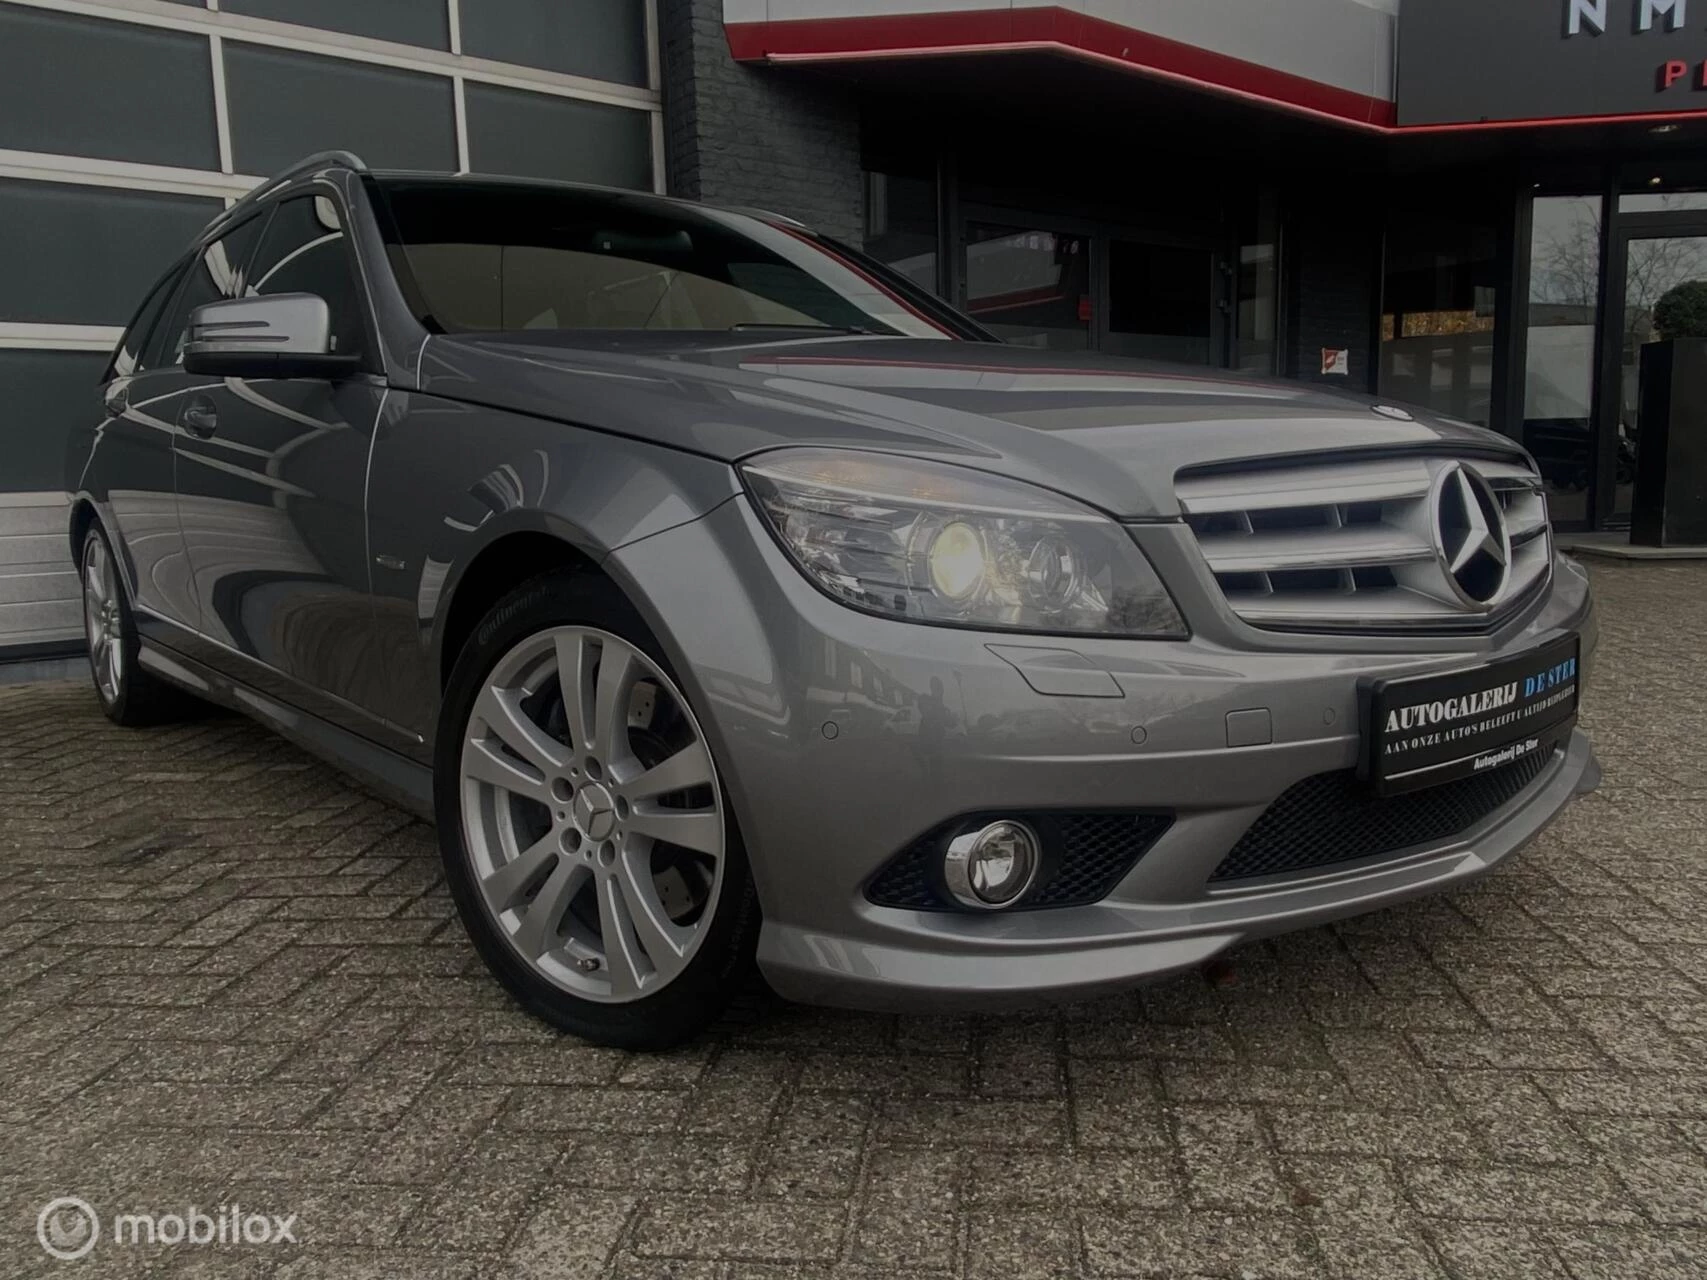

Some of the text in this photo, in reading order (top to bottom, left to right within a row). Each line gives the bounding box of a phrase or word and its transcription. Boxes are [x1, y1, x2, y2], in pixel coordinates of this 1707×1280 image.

[1665, 60, 1707, 89] P
[1384, 658, 1575, 733] AUTOGALERIJ DE STER
[1384, 739, 1409, 756] AAN
[1411, 733, 1442, 749] ONZE
[1473, 738, 1539, 770] Autogalerij De Ster
